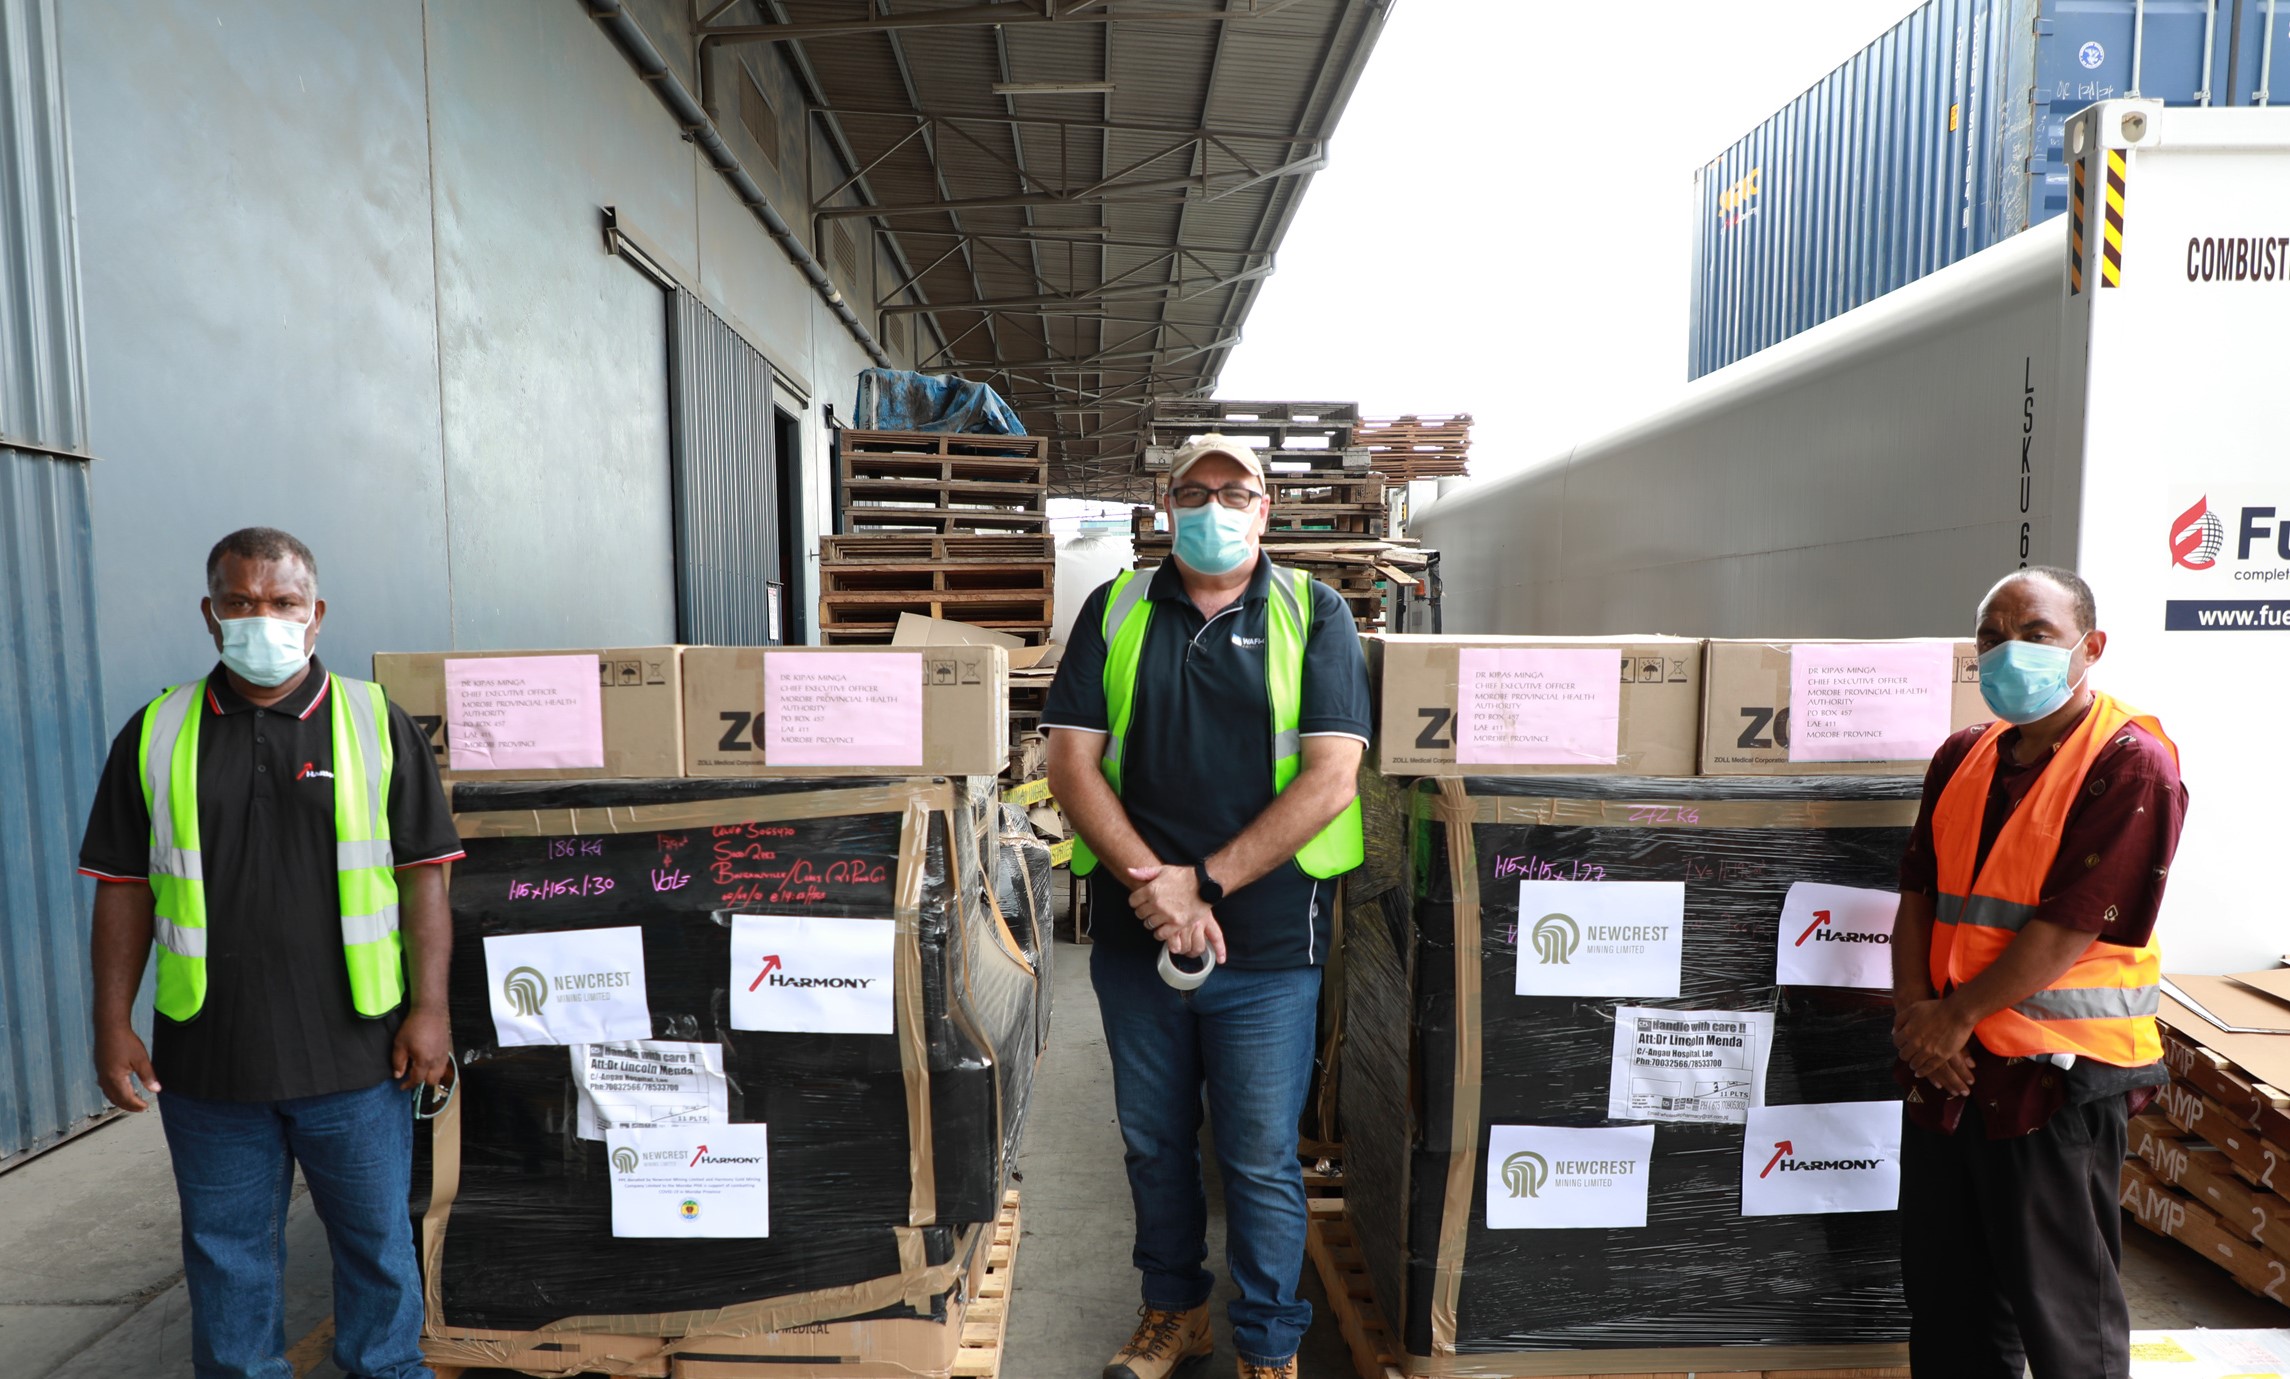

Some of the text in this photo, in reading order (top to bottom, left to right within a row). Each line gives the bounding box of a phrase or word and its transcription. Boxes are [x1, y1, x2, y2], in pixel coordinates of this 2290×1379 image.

[2187, 238, 2290, 282] COMBUST
[2019, 522, 2030, 569] 6
[1475, 671, 1487, 679] DR
[1514, 671, 1543, 679] MINGA
[1821, 666, 1844, 674] KIPAS
[1808, 677, 1908, 686] CHIEF EXECUTIVE OFFICER
[1511, 693, 1559, 701] PROVINCIAL
[1807, 687, 1928, 696] MOROBE PROVINCIAL HEALTH
[1807, 698, 1855, 706] AUTHORITY
[1807, 709, 1818, 717] PO
[1821, 709, 1838, 717] BOX
[1843, 730, 1883, 738] PROVINCE
[549, 838, 577, 860] 186
[1587, 926, 1669, 942] NEWCREST
[1587, 945, 1645, 954] MINING LIMITED
[554, 971, 631, 991] NEWCREST
[770, 973, 872, 989] HARMONY
[557, 991, 611, 1003] MINING LIMITED
[1652, 1020, 1690, 1032] Handle
[1691, 1022, 1710, 1032] with
[1712, 1023, 1737, 1033] care
[1670, 1034, 1704, 1047] Lincoln
[1706, 1035, 1742, 1047] Menda
[604, 1045, 639, 1059] Handle
[641, 1051, 661, 1062] with
[663, 1053, 686, 1063] care
[620, 1060, 656, 1074] Lincoln
[660, 1065, 693, 1076] Menda
[2155, 1083, 2277, 1189] AMP 2
[643, 1151, 689, 1161] NEWCREST
[701, 1156, 761, 1164] HARMONY
[1556, 1160, 1637, 1176] NEWCREST
[1780, 1158, 1880, 1172] HARMONY
[1555, 1179, 1613, 1188] MINING LIMITED
[2137, 1132, 2267, 1244] AMP 2
[2120, 1179, 2287, 1303] AMP 2
